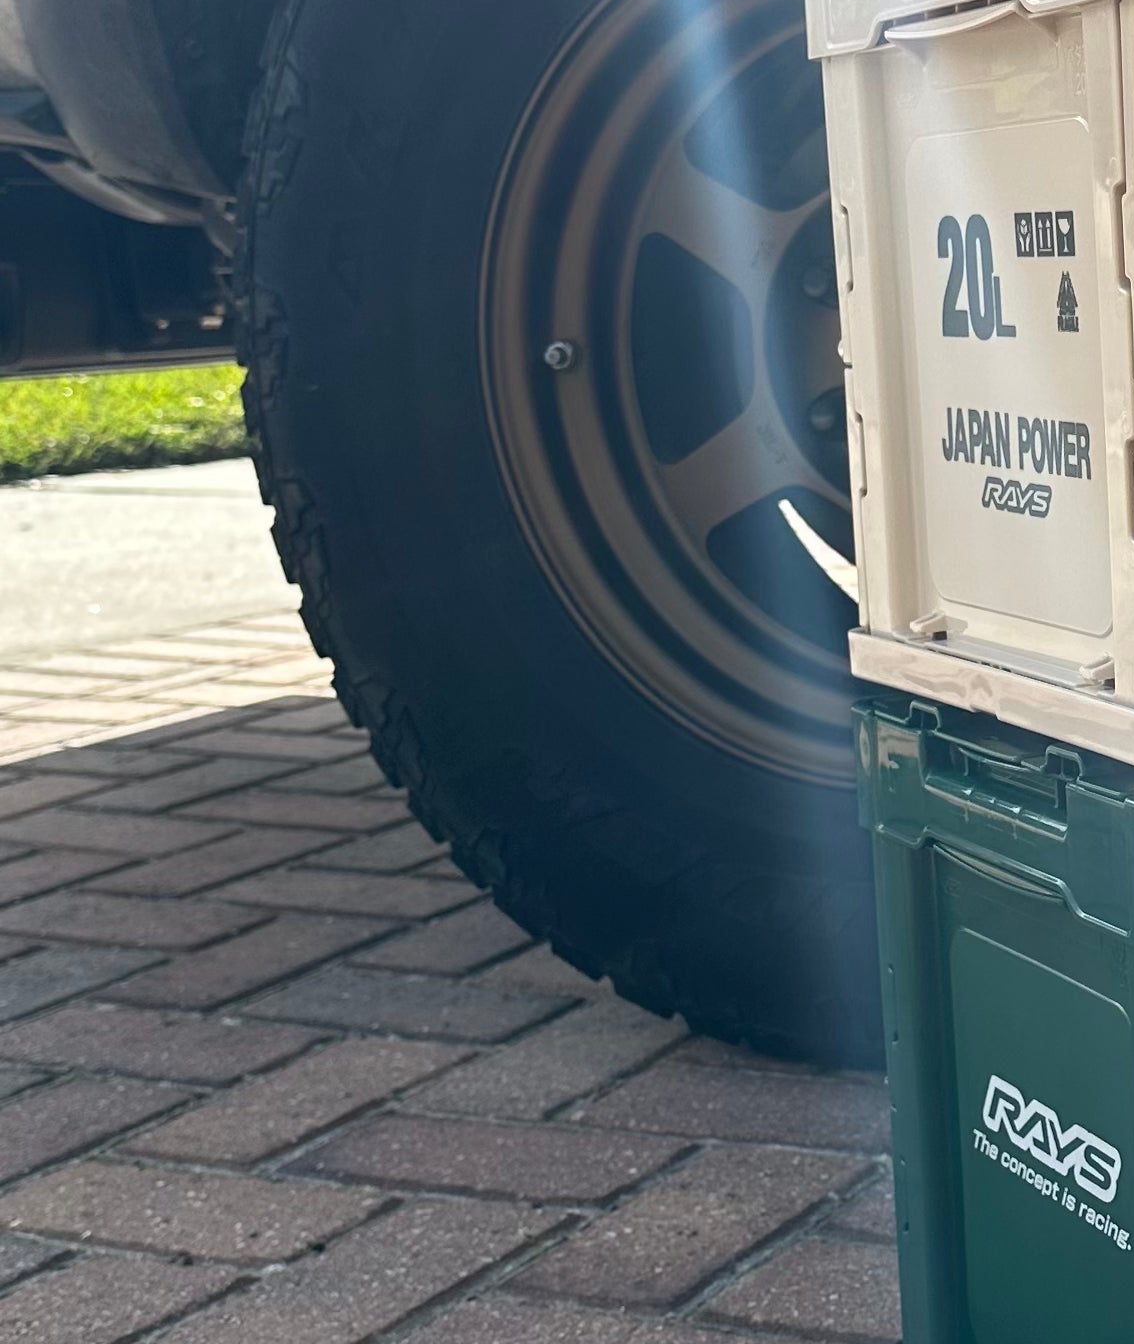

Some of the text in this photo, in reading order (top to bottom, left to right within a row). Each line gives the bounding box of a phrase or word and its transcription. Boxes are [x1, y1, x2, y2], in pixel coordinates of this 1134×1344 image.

[937, 213, 1016, 341] 20L
[942, 407, 1091, 480] JAPAN POWER
[981, 476, 1052, 518] RAYS
[972, 1128, 1132, 1251] The concept is racing.
[982, 1074, 1122, 1203] RAYS
